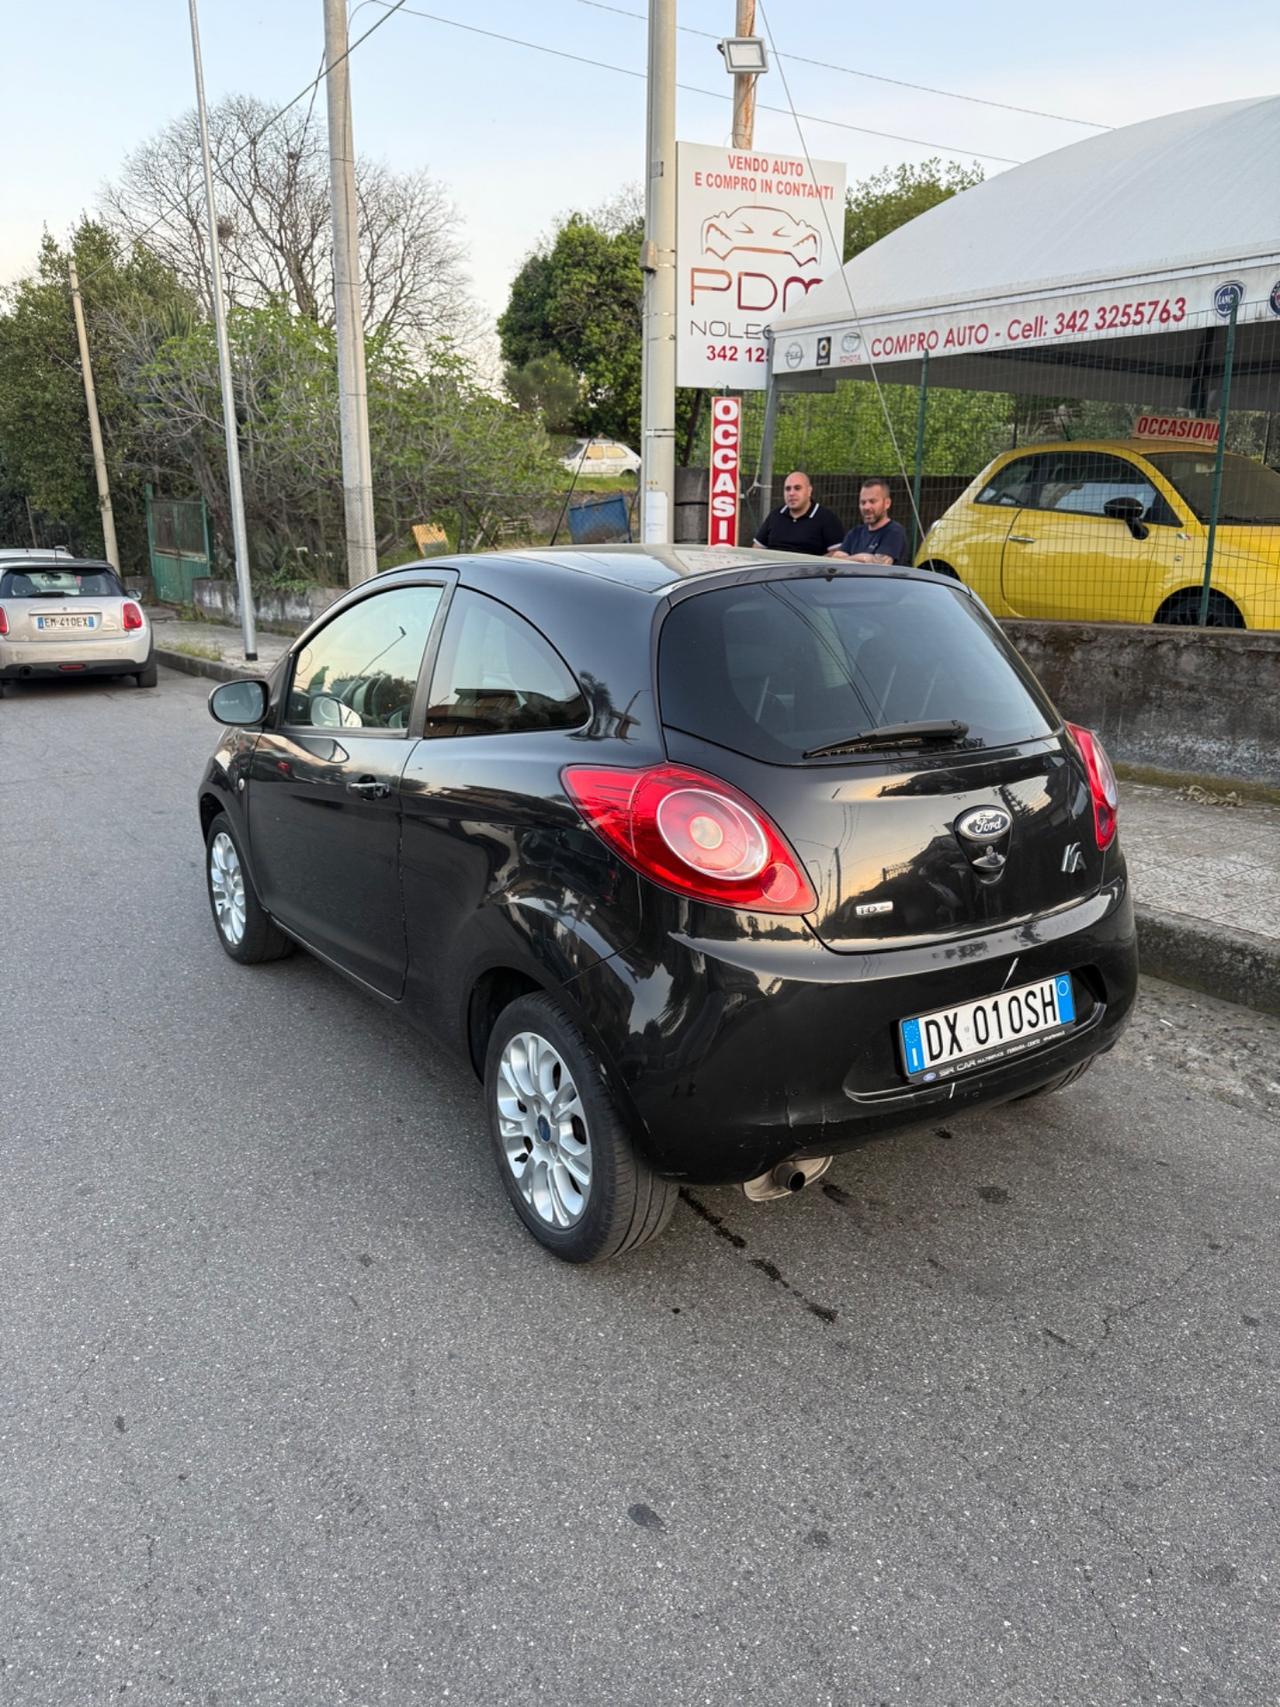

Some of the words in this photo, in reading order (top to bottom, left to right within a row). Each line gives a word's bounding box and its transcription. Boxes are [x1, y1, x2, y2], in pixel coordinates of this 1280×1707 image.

[728, 154, 769, 173] VENDO
[772, 161, 804, 177] AUTO
[695, 172, 702, 187] E
[706, 173, 757, 192] COMPRO
[760, 179, 773, 194] IN
[776, 181, 834, 200] CONTANTI
[871, 330, 940, 357] COMPRO
[943, 324, 989, 349] AUTO
[1007, 316, 1049, 341] Cell:
[1053, 309, 1089, 335] 342
[1094, 297, 1187, 330] 3255763
[706, 345, 738, 361] 342
[745, 347, 769, 363] 12
[712, 400, 738, 548] OCCASI
[974, 816, 1003, 833] Ford
[925, 1010, 964, 1062] DX
[973, 982, 1059, 1044] 010SH
